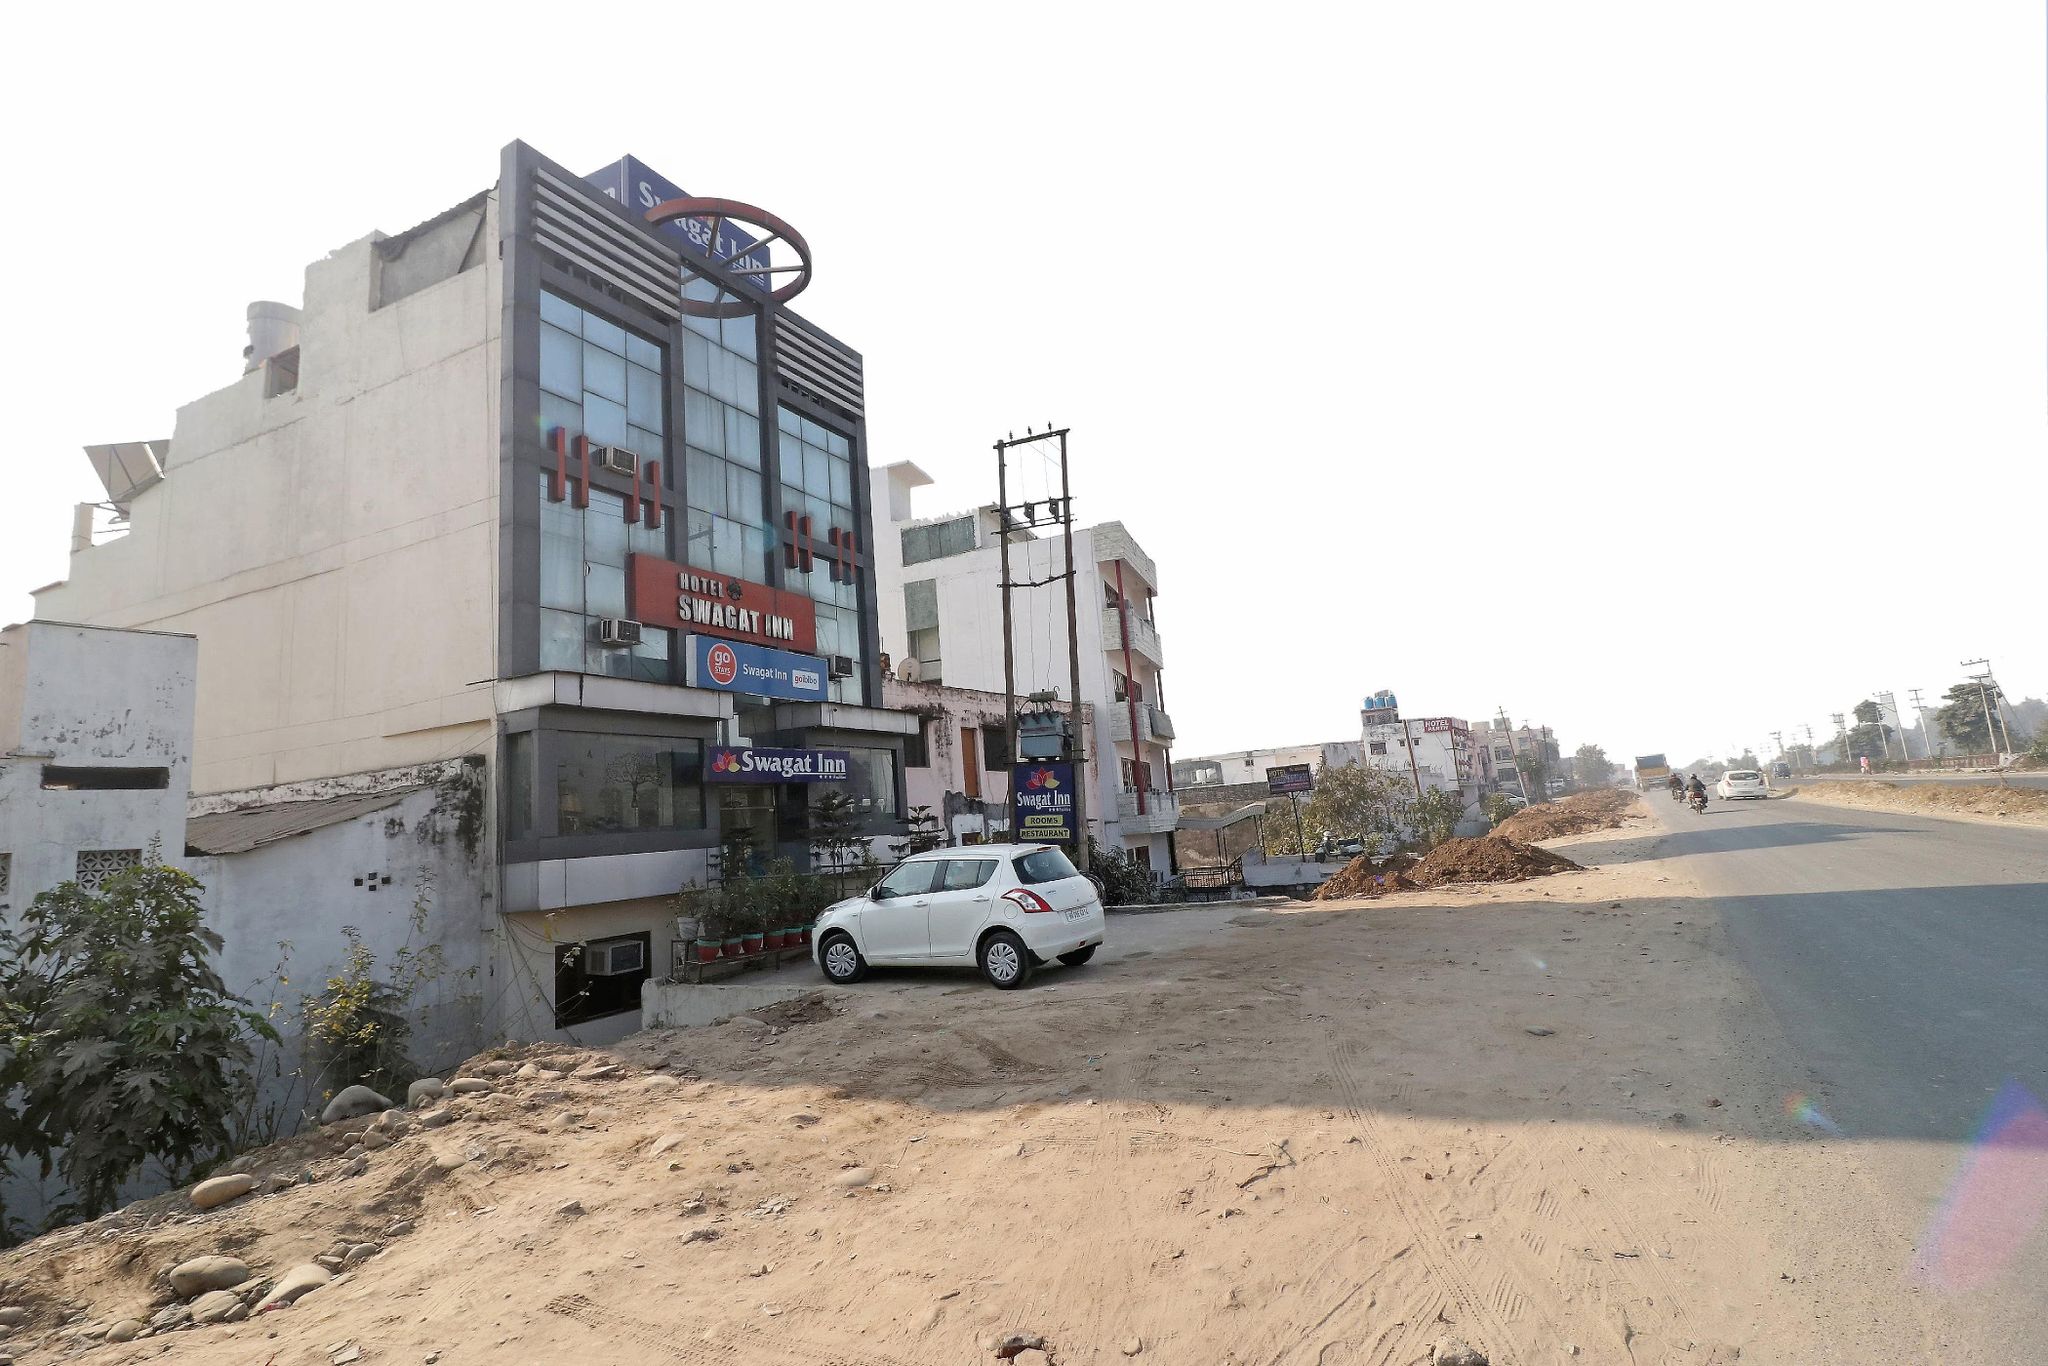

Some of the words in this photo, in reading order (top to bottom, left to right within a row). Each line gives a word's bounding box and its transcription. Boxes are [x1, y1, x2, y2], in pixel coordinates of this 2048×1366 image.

[679, 572, 724, 598] HOTEL
[678, 594, 760, 634] SWAGAT
[765, 614, 794, 641] INN
[714, 651, 731, 665] go
[714, 665, 731, 673] STAYS
[743, 663, 773, 680] Swagat
[774, 670, 788, 681] Inn
[741, 750, 812, 777] Swagat
[817, 753, 846, 773] Inn
[1017, 791, 1051, 810] Swagat
[1054, 790, 1070, 805] Inn
